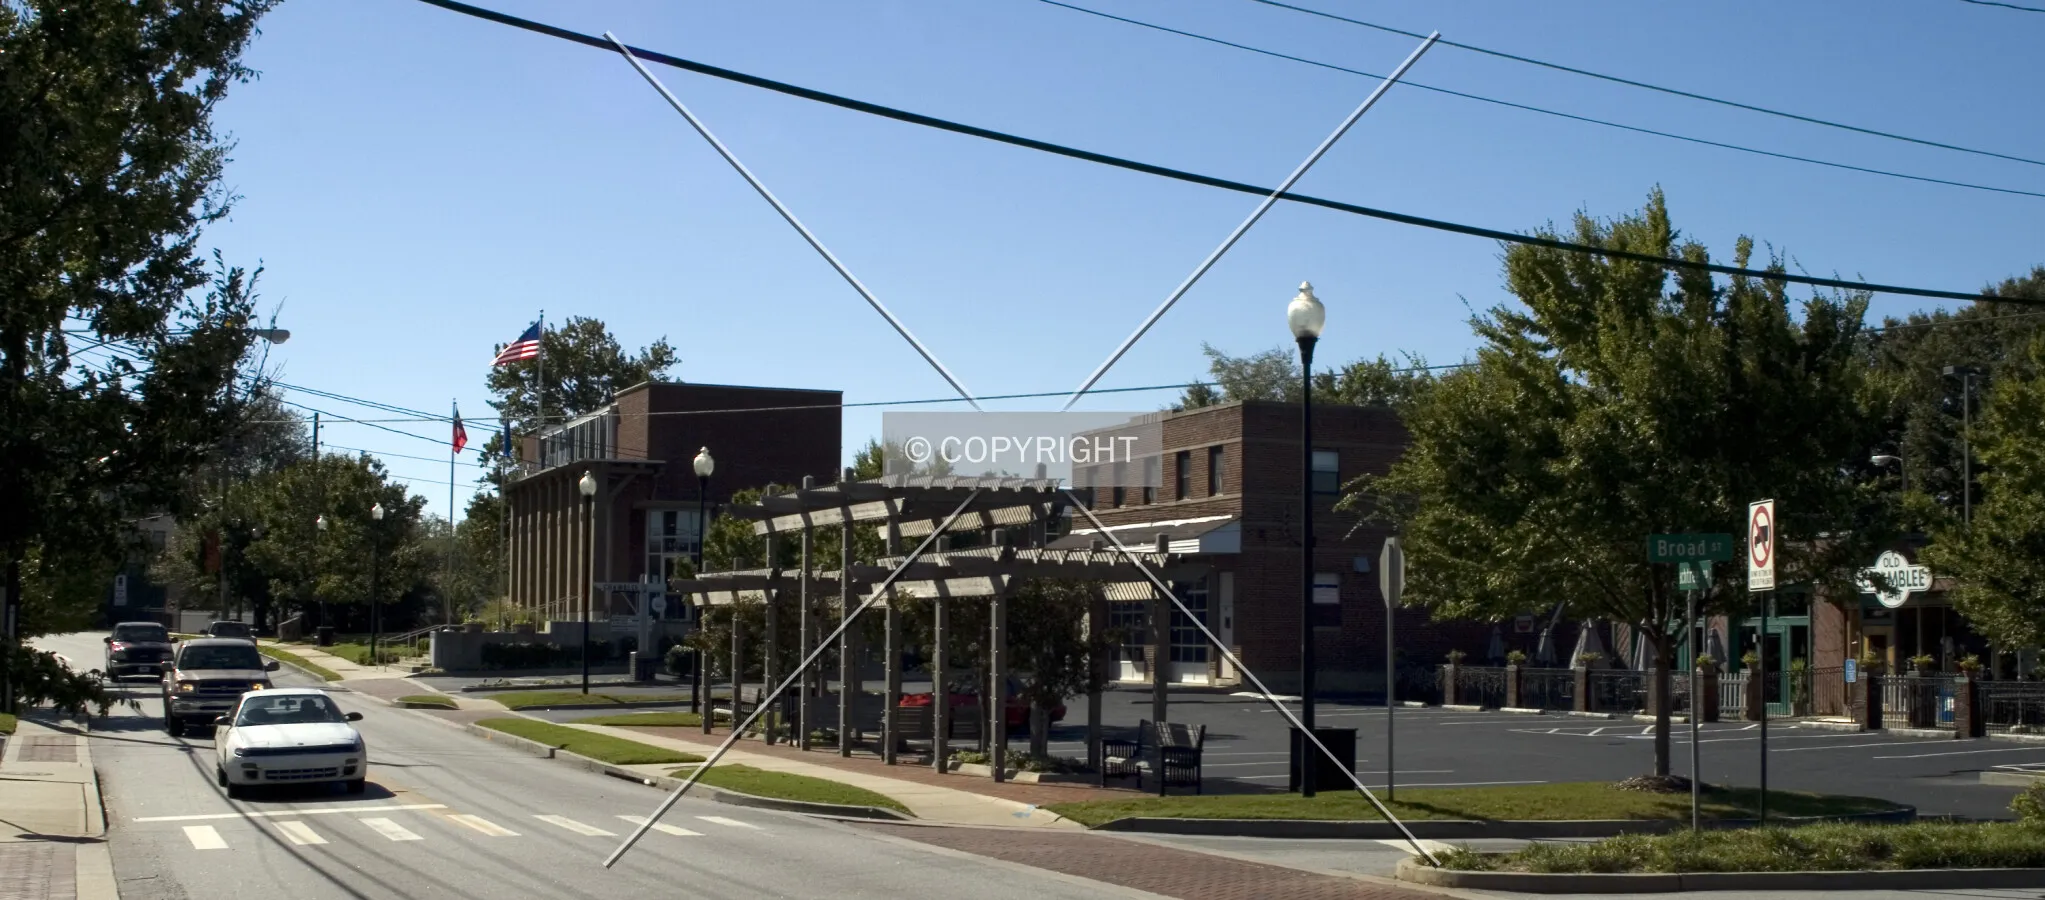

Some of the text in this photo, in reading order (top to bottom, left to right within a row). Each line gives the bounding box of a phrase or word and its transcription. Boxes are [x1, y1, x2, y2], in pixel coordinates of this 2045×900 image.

[1657, 539, 1706, 556] Broad
[1883, 558, 1900, 567] OLD
[1862, 569, 1925, 588] CMBLEE
